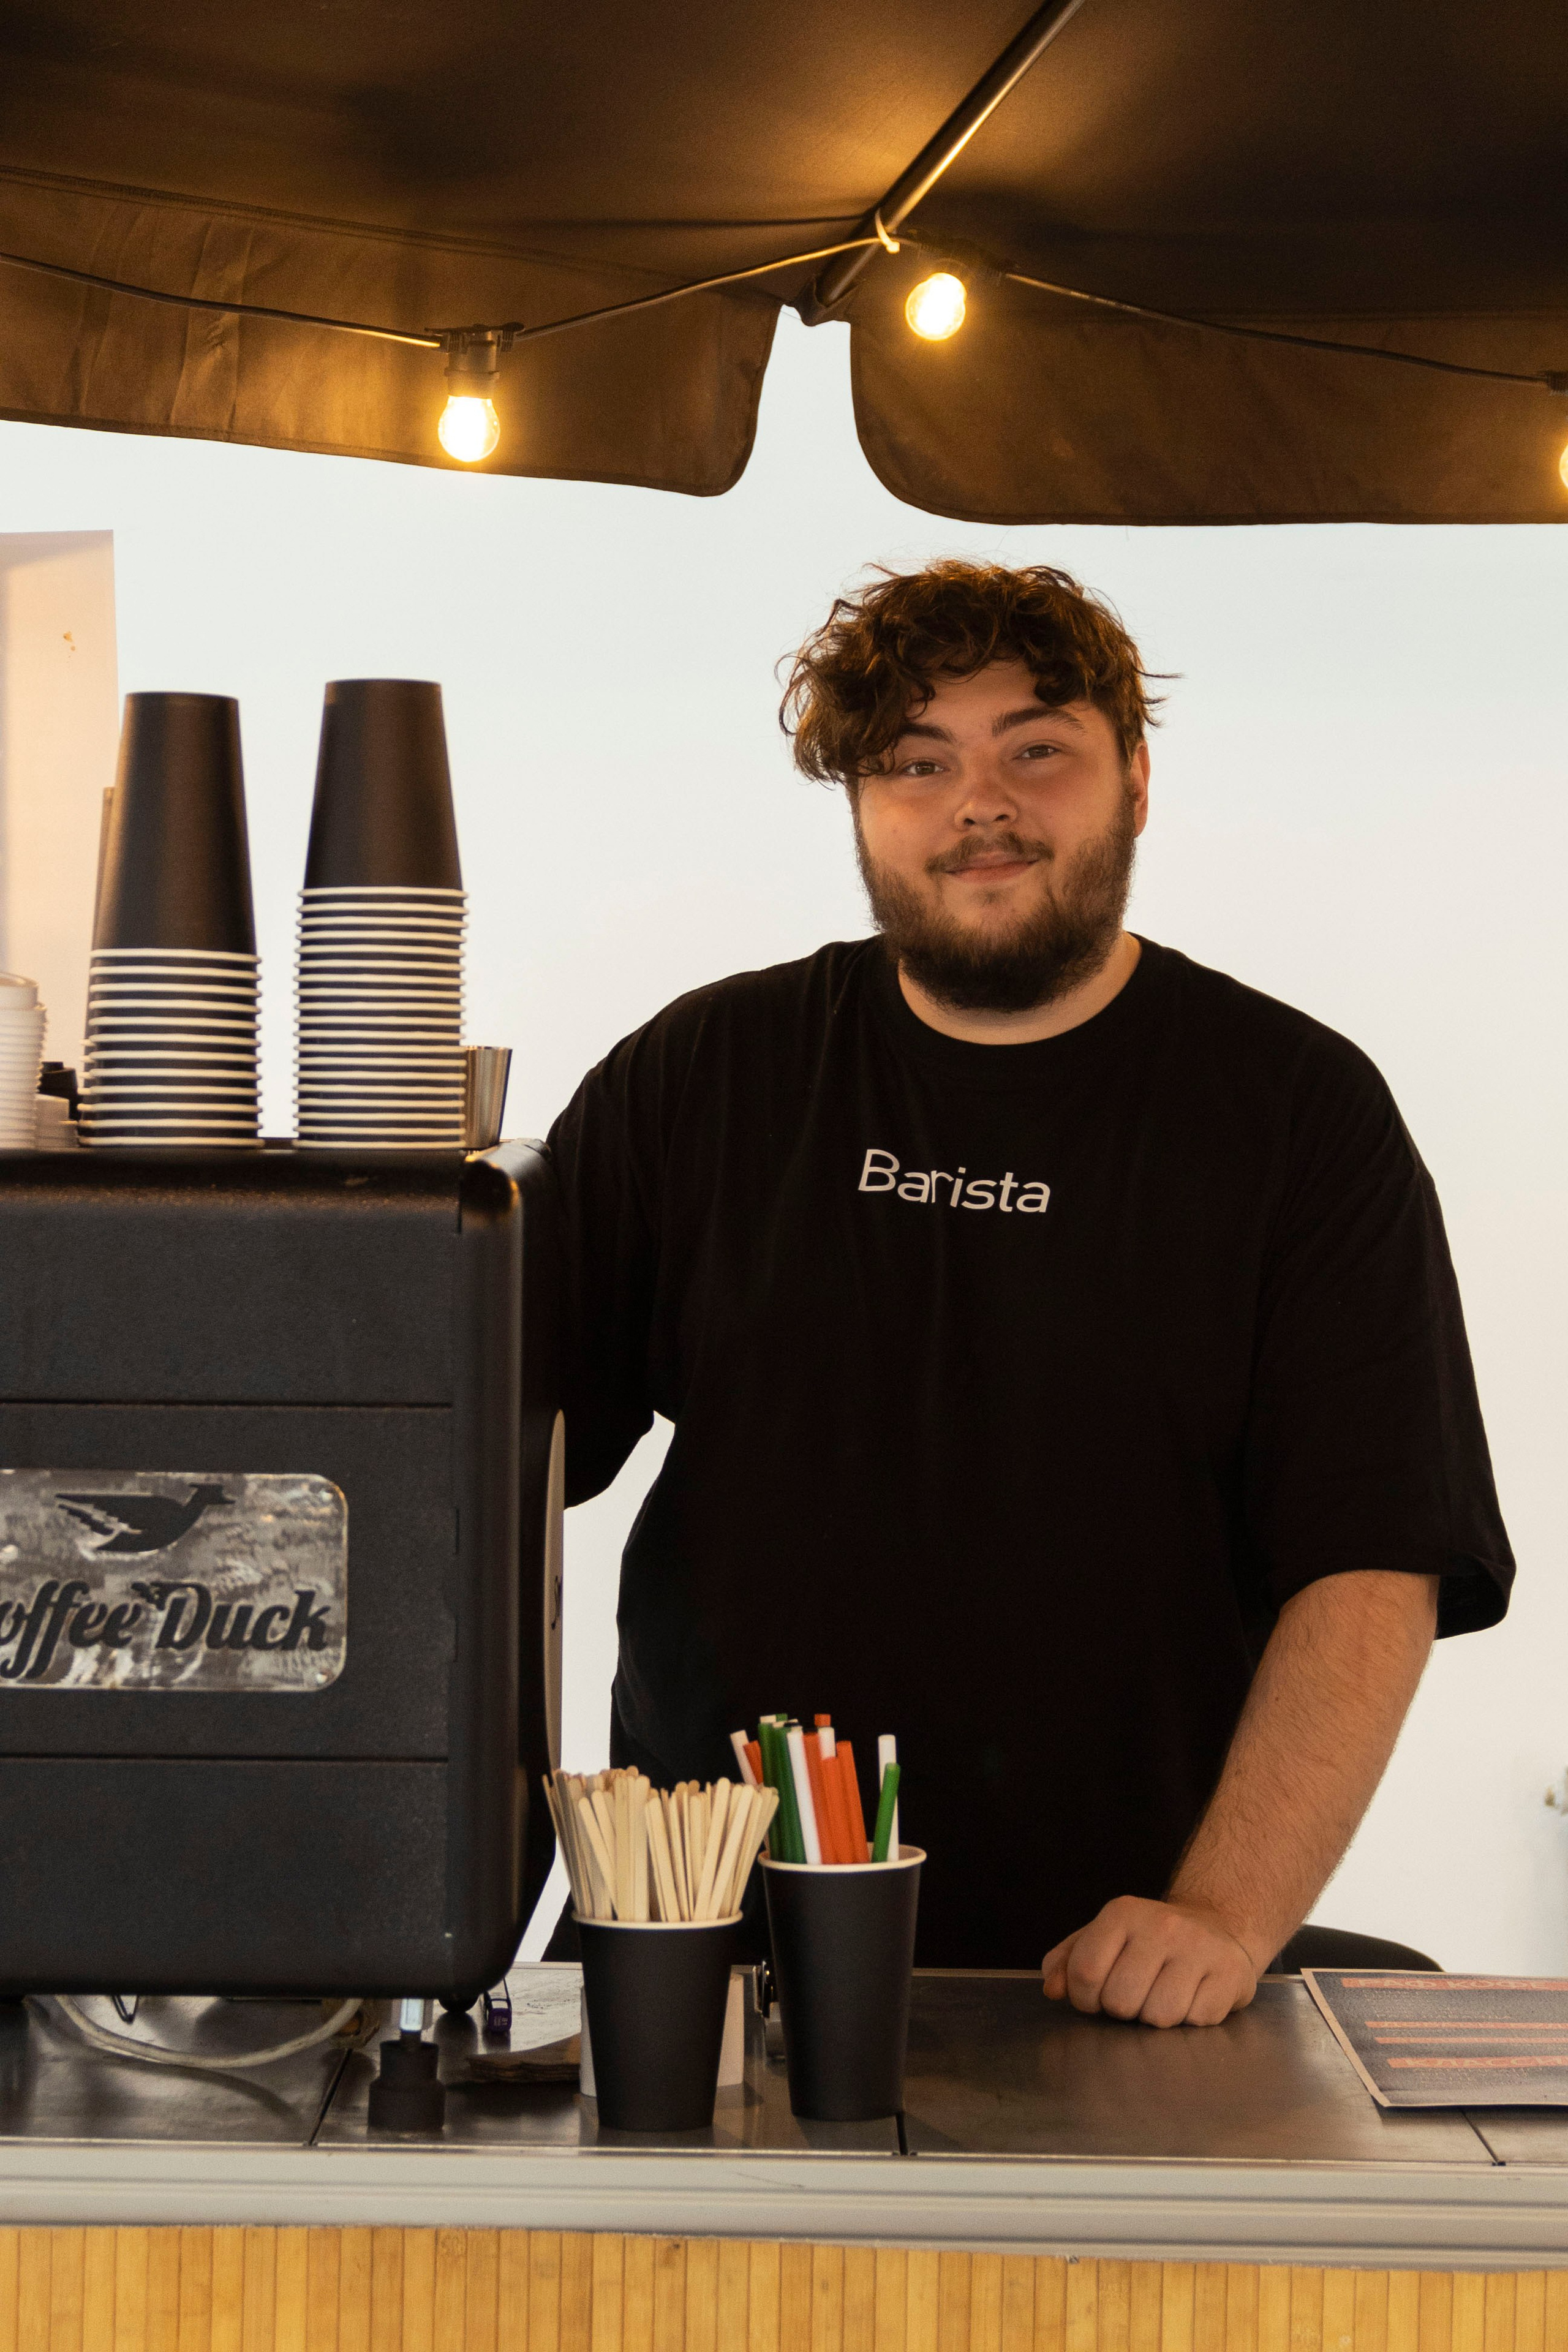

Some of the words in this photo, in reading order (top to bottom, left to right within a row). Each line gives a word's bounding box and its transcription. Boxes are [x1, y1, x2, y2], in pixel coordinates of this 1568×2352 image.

[858, 1149, 1051, 1213] Barista
[0, 1580, 141, 1679] offee
[132, 1581, 331, 1651] Duck
[1357, 1979, 1438, 1988] РАФ
[1446, 1980, 1549, 1989] КОФЕ
[1406, 2056, 1568, 2067] КЛАССИ
